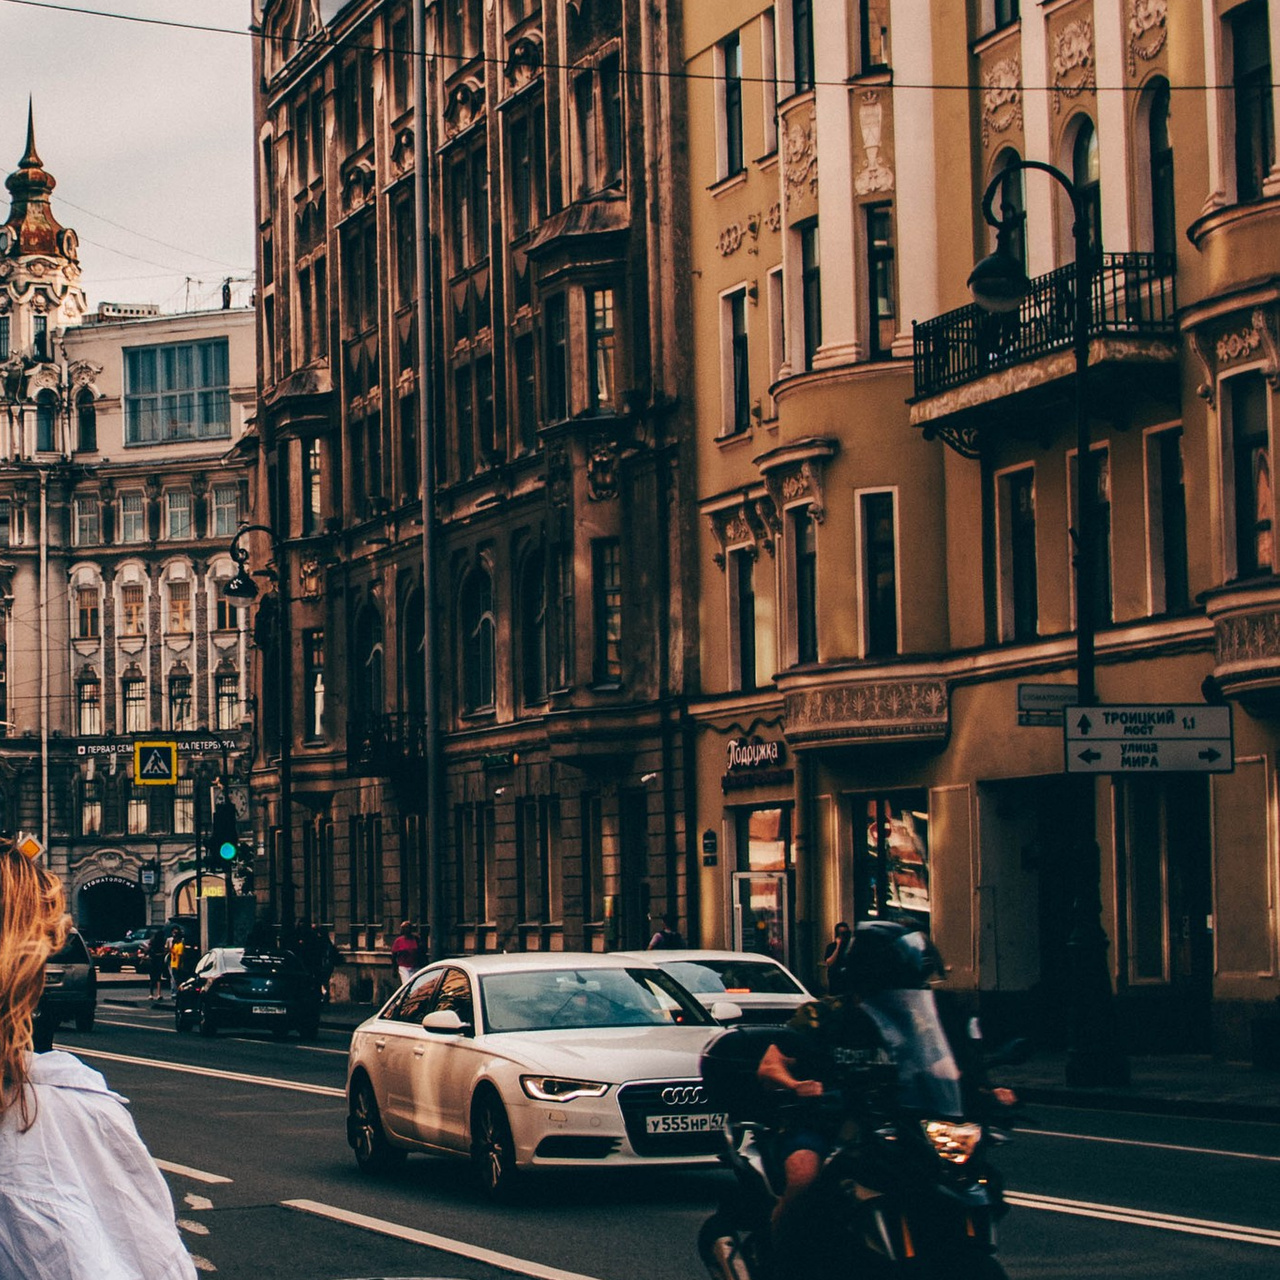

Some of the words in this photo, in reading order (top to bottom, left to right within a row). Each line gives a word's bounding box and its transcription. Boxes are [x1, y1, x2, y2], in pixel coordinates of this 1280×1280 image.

[1102, 709, 1176, 725] ТРОИЦКИЙ
[87, 744, 116, 754] ПЕРВАЯ
[117, 744, 134, 753] СЕМ
[726, 738, 779, 770] Подружка
[1120, 742, 1158, 755] улица
[1120, 755, 1159, 768] МИРА
[195, 885, 223, 897] АФЕ
